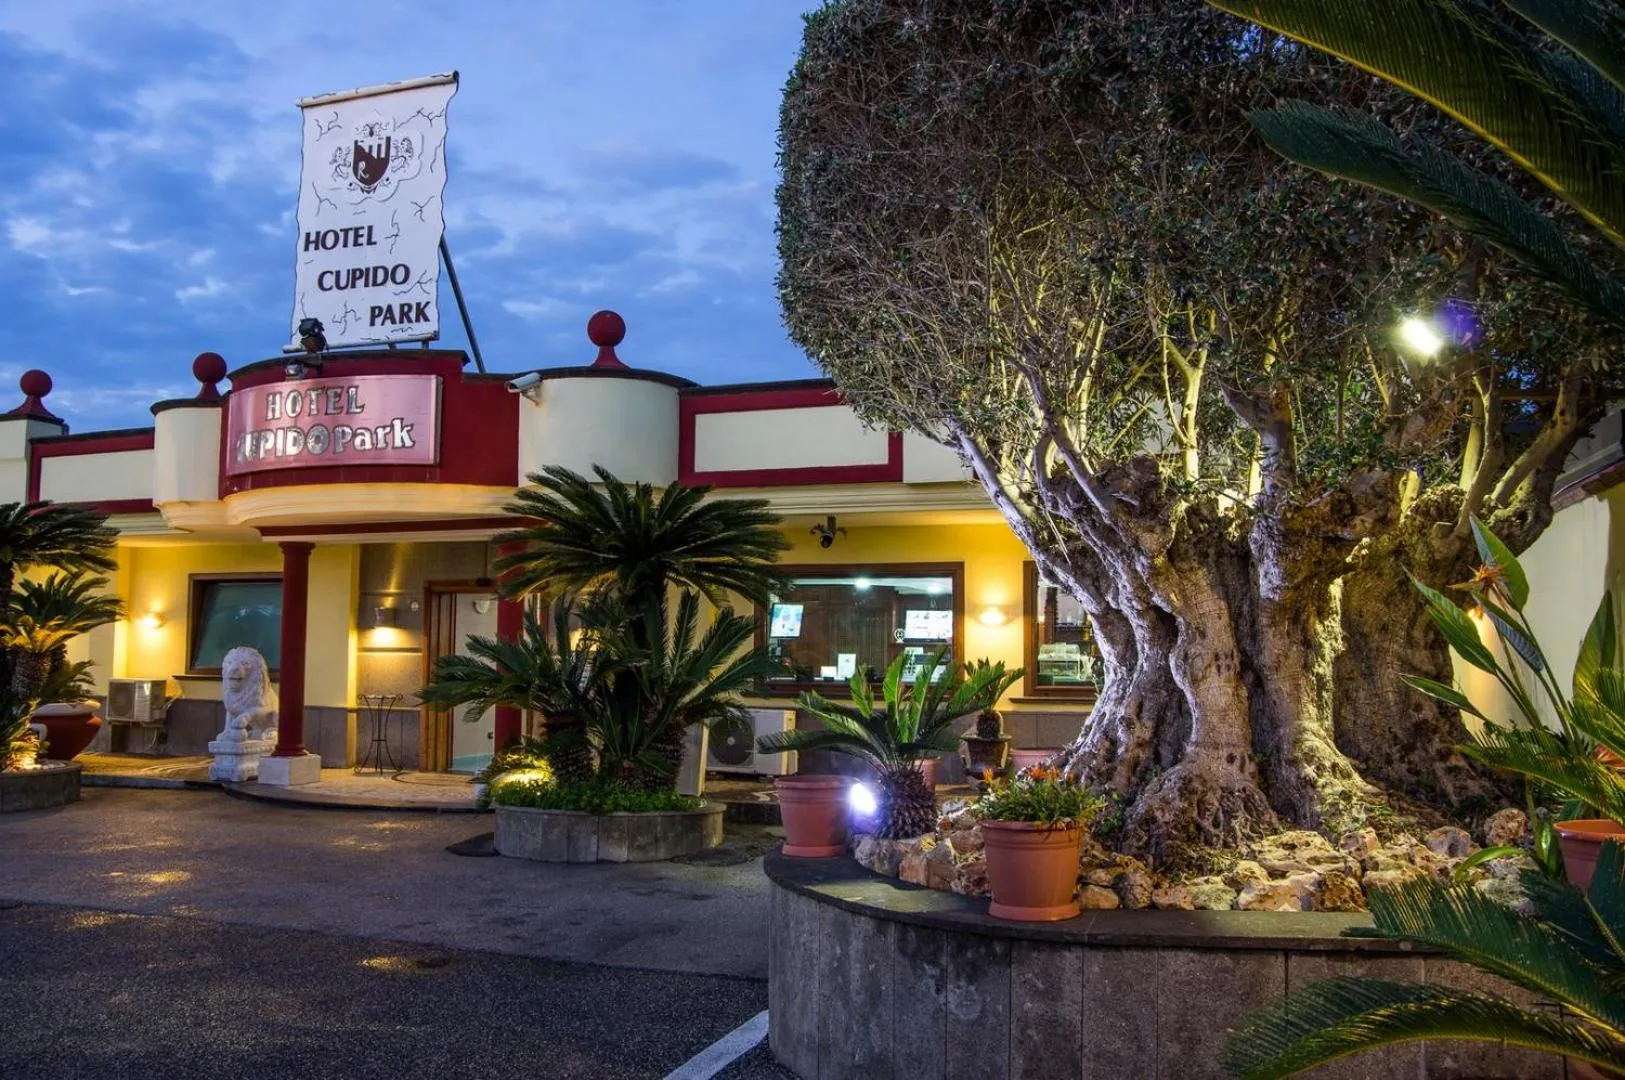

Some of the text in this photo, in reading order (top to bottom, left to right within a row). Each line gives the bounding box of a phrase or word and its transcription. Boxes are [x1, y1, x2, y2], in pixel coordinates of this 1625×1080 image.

[303, 225, 377, 252] HOTEL
[317, 263, 410, 291] CUPIDO
[369, 301, 431, 327] PARK
[265, 385, 365, 421] HOTEL
